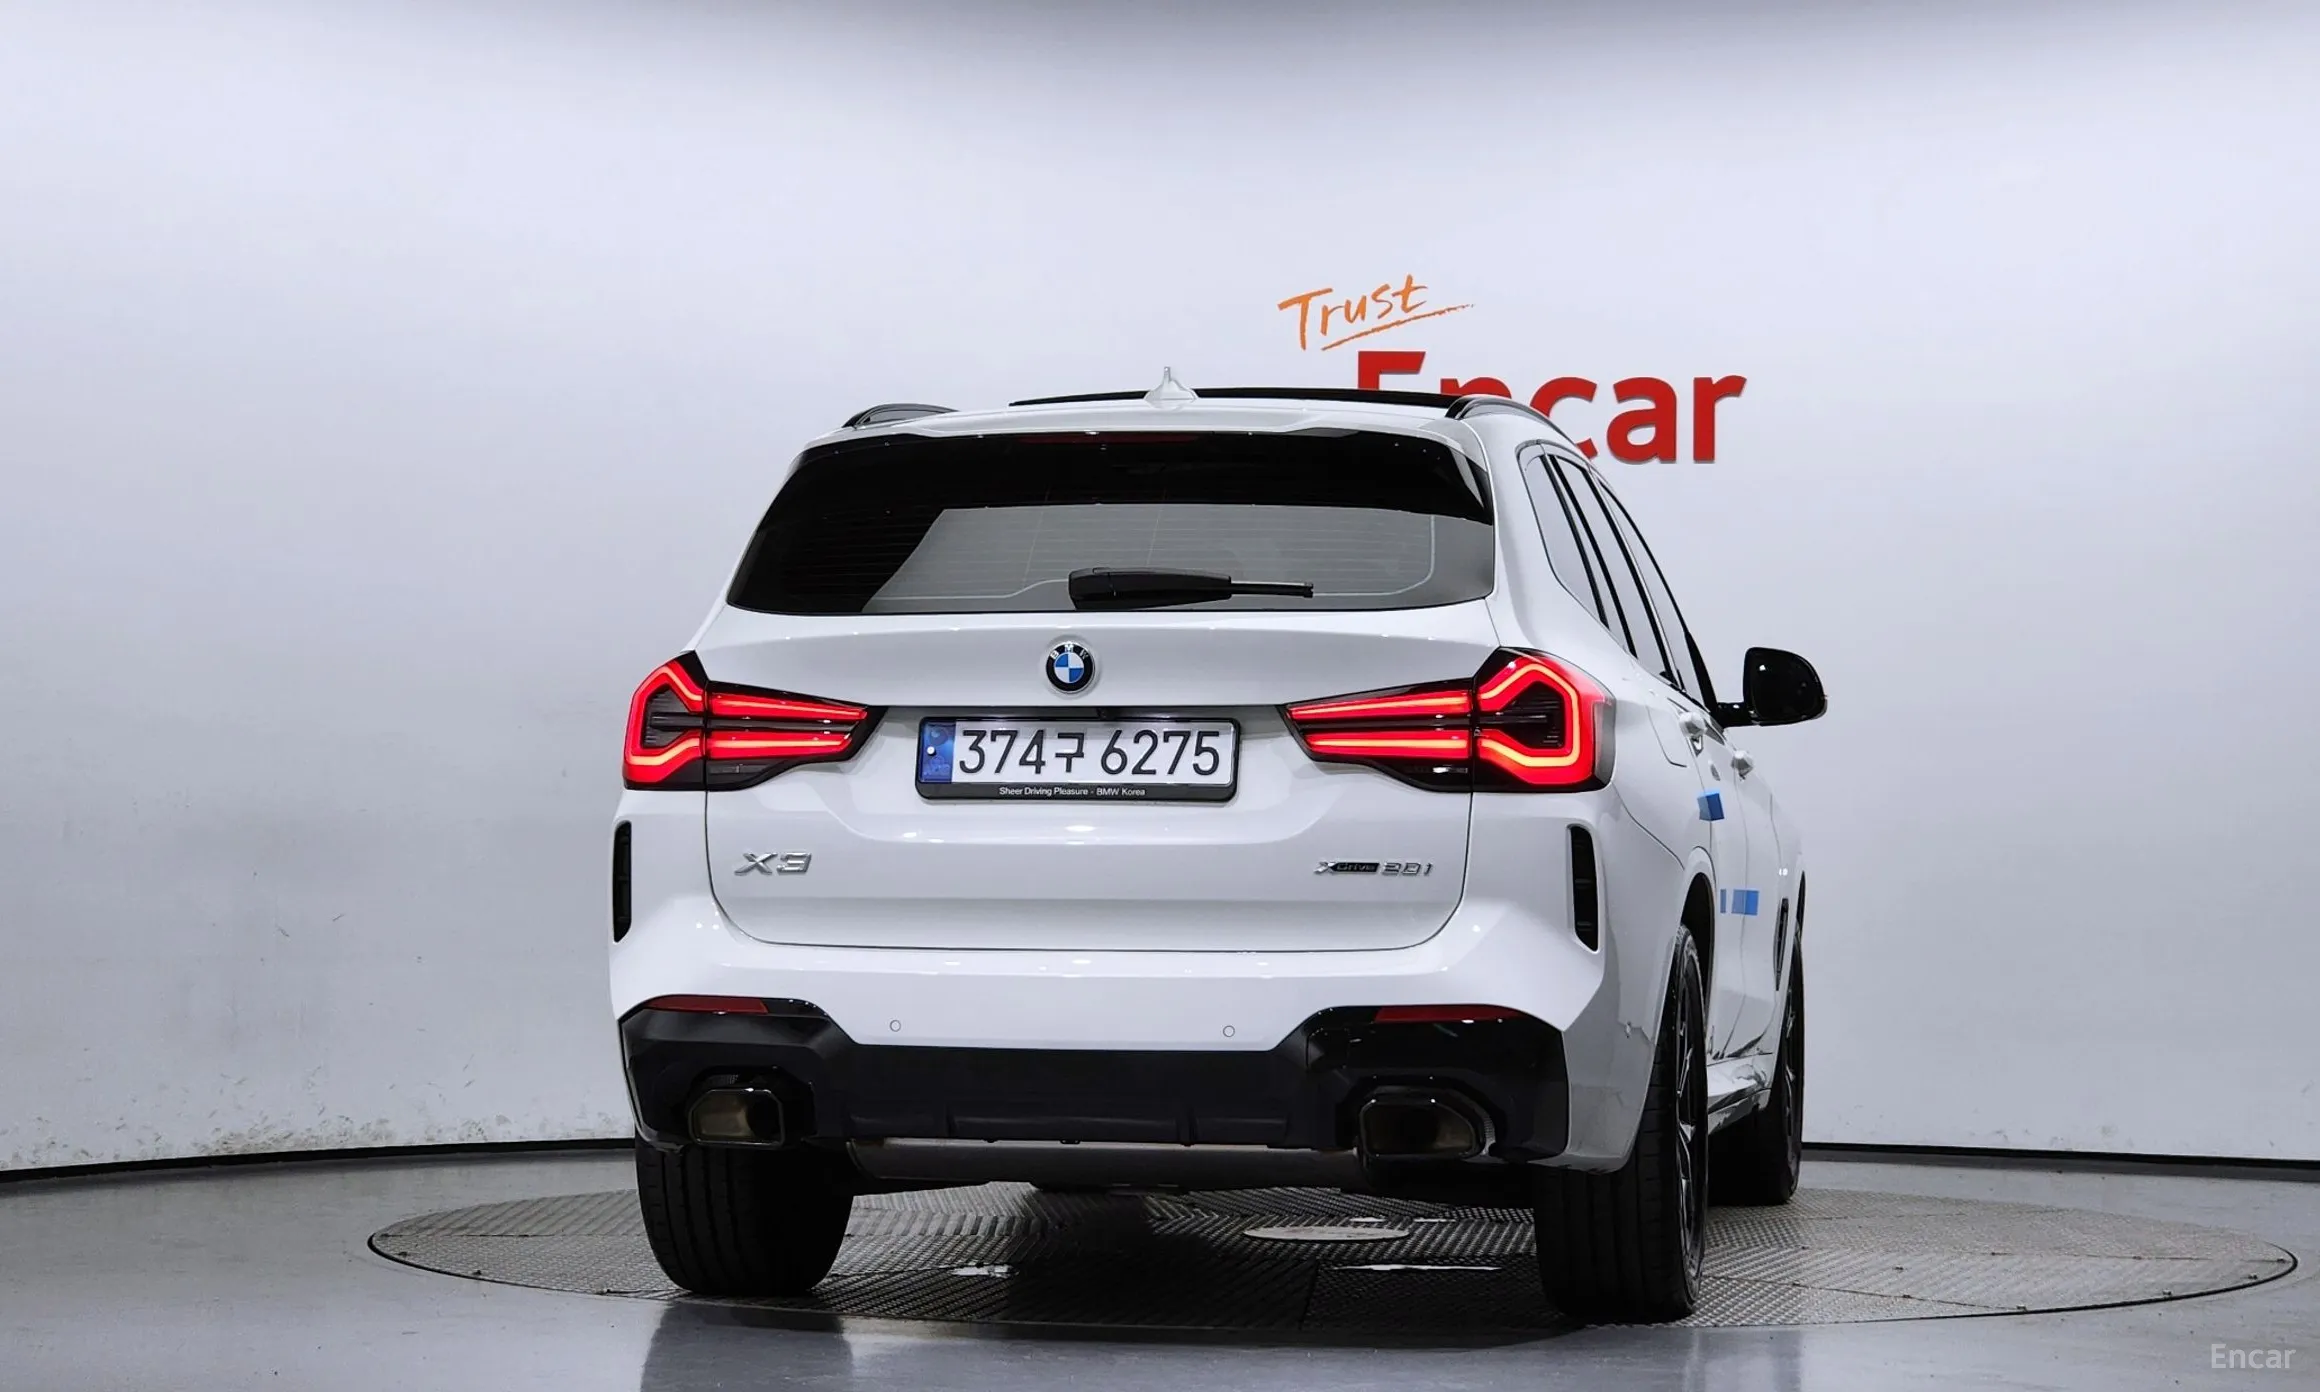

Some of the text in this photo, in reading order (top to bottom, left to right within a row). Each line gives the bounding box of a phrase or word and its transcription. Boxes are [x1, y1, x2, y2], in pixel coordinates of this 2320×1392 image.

[1277, 274, 1430, 350] Trust
[1357, 350, 1748, 463] car
[958, 729, 1221, 777] 374구 6275
[998, 786, 1023, 796] Sheer
[1024, 786, 1052, 797] Driving
[1053, 786, 1089, 796] Pleasure
[1096, 787, 1120, 796] BMW
[1121, 787, 1146, 796] Korea
[734, 852, 812, 876] X3
